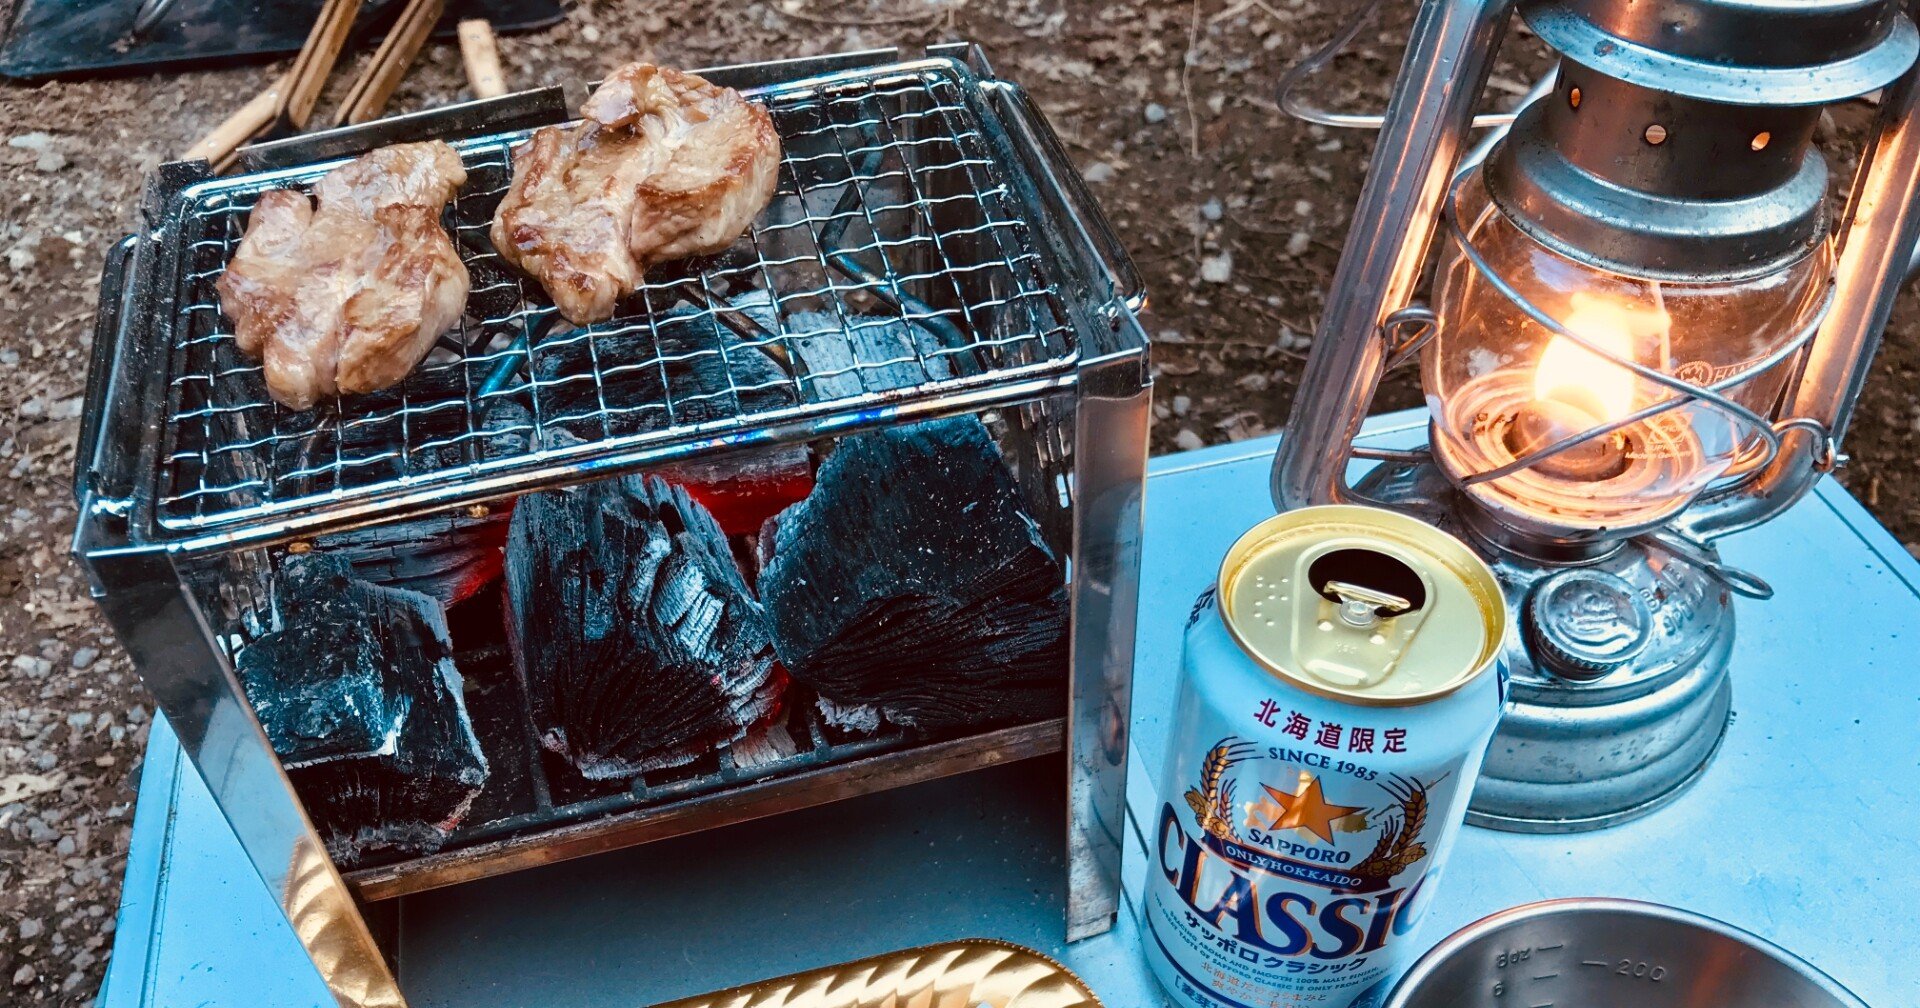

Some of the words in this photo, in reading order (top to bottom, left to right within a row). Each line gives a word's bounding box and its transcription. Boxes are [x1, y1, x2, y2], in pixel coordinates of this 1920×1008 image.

[1253, 698, 1407, 754] 北海道限定
[1268, 747, 1331, 769] SINCE
[1335, 760, 1379, 781] 1985
[1248, 828, 1351, 865] SAPPORO
[1157, 801, 1441, 960] CLASSIC
[1226, 845, 1267, 868] ONLY
[1268, 859, 1362, 888] HOKKAIDO
[1184, 910, 1367, 975] サッポロクラシック
[1496, 948, 1532, 969] 8oz
[1229, 959, 1250, 971] AND
[1251, 968, 1293, 982] SMOOTH
[1322, 976, 1346, 984] MALT
[1615, 957, 1666, 982] 200
[1307, 984, 1332, 992] ONLY
